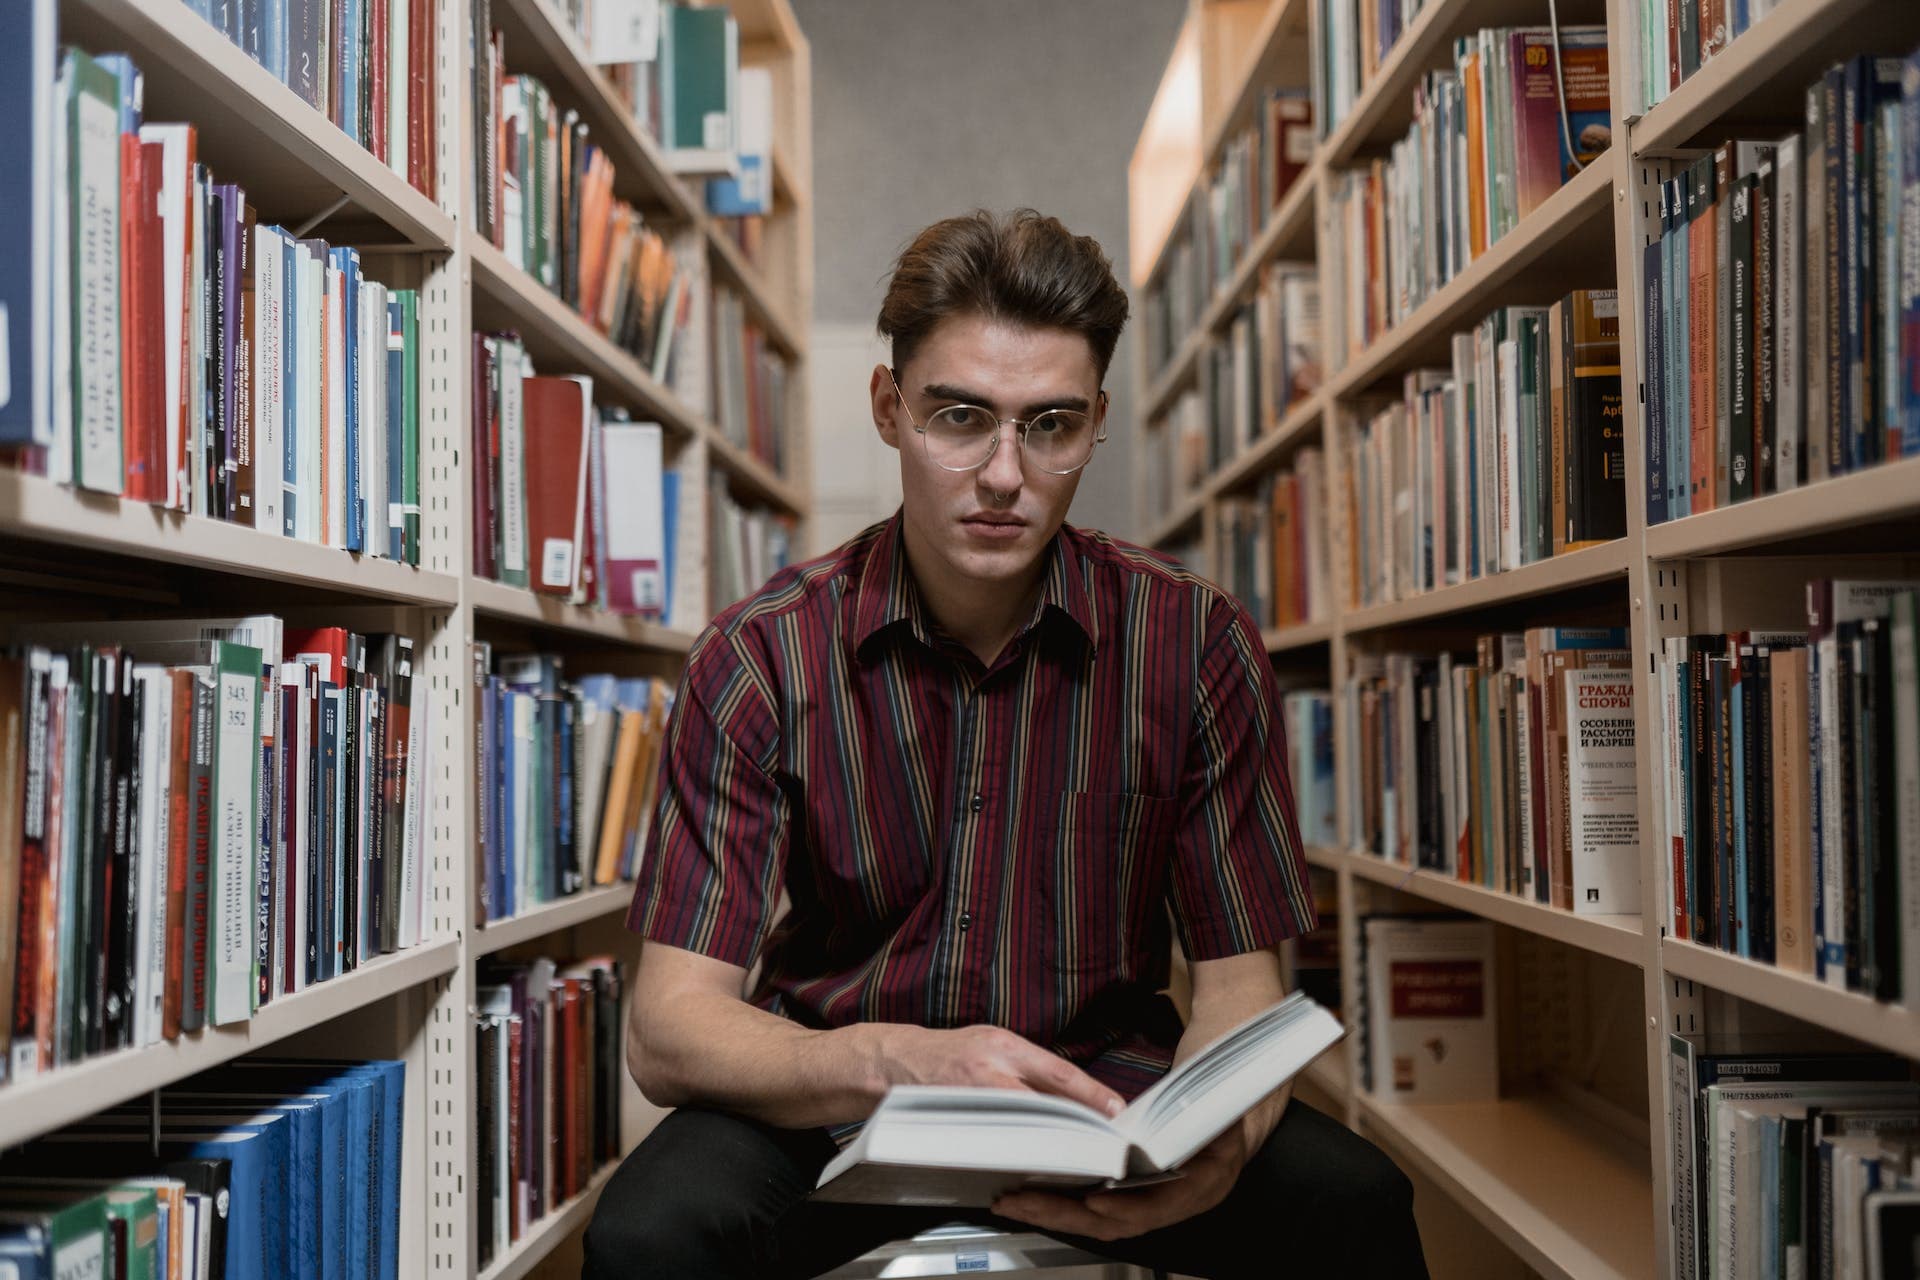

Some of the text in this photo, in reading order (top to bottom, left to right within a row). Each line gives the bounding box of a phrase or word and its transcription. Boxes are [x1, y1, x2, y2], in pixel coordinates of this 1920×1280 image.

[302, 52, 310, 78] 2
[1733, 259, 1745, 415] Прокурорский надзор
[1784, 326, 1793, 387] НАДЗОР
[1763, 335, 1772, 402] НАДЗОР
[1579, 685, 1633, 697] ГРАЖДА
[1695, 650, 1703, 689] России
[1579, 698, 1630, 708] СПОРЫ
[1582, 739, 1588, 747] И
[395, 739, 403, 803] КОРРУПЦИИ
[1721, 698, 1733, 846] АДВОКАТУРА
